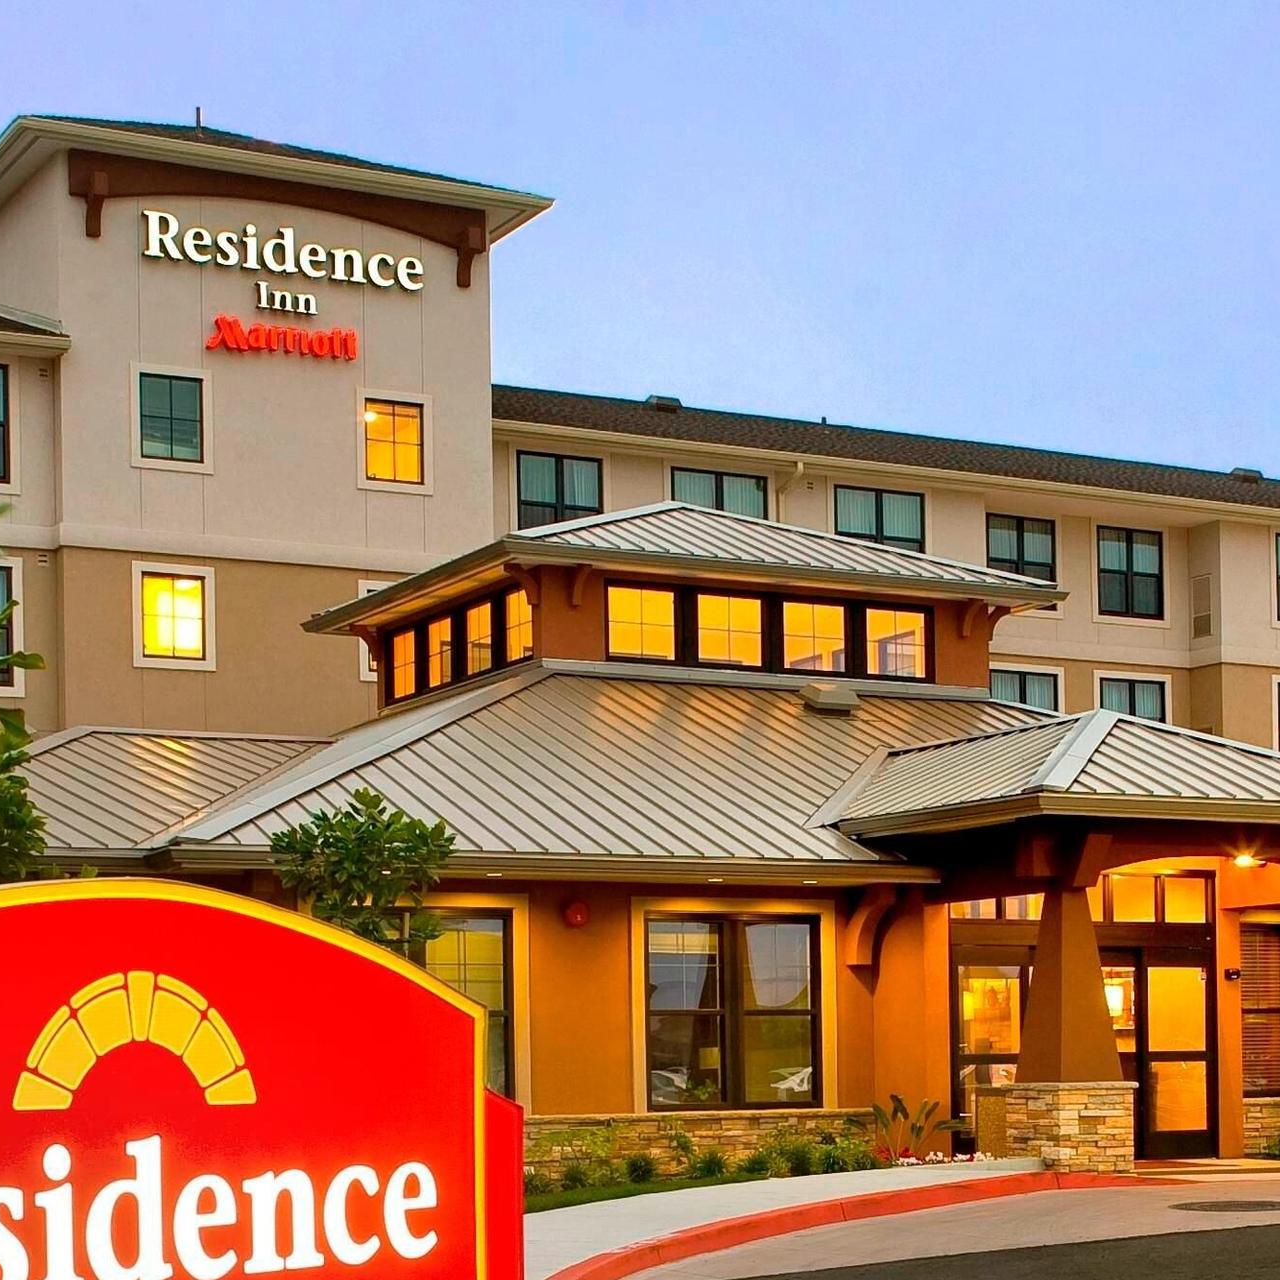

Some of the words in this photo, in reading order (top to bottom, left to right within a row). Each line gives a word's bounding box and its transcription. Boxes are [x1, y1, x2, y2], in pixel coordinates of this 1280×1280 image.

[142, 209, 425, 291] Residence
[256, 280, 318, 315] Inn
[205, 313, 359, 361] Marriott
